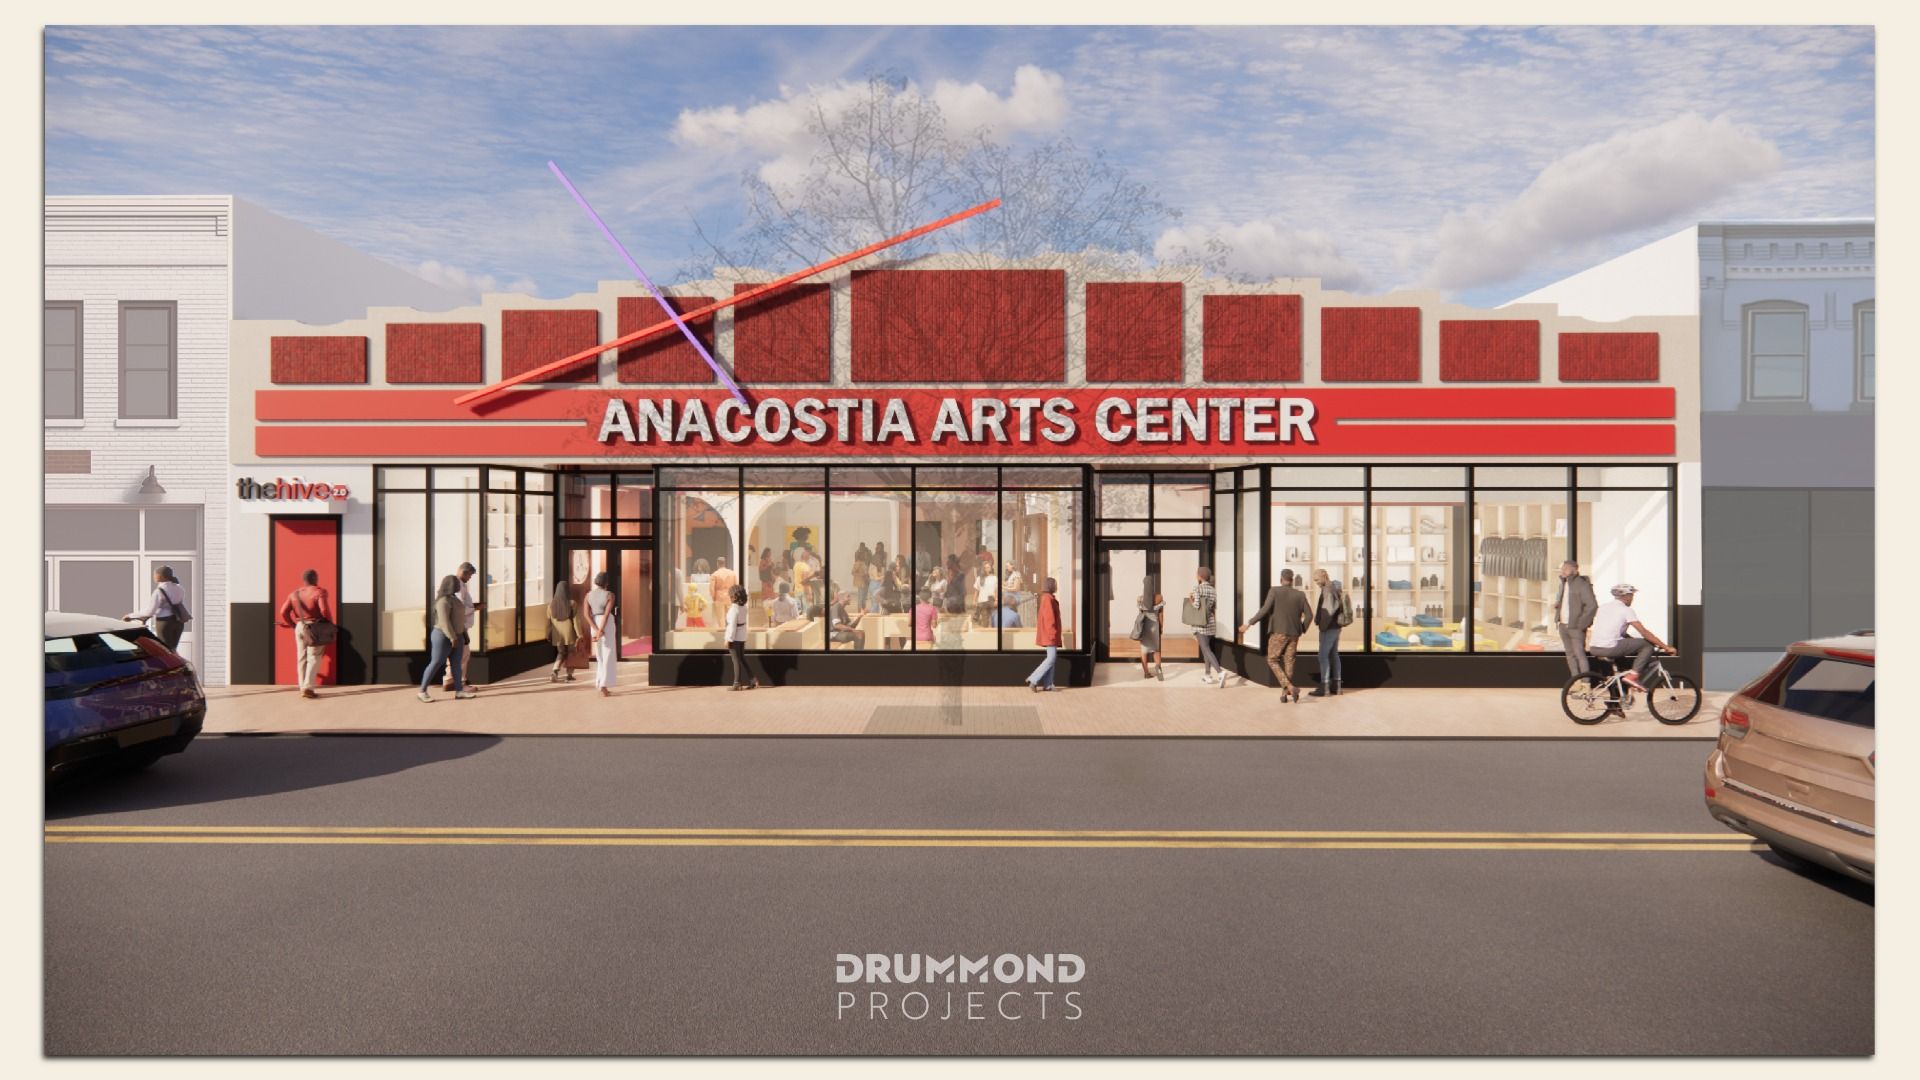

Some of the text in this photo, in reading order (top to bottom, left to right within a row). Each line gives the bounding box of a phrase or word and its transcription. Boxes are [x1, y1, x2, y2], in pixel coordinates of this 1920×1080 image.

[597, 396, 1315, 443] ANACOSTIA ARTS CENTER
